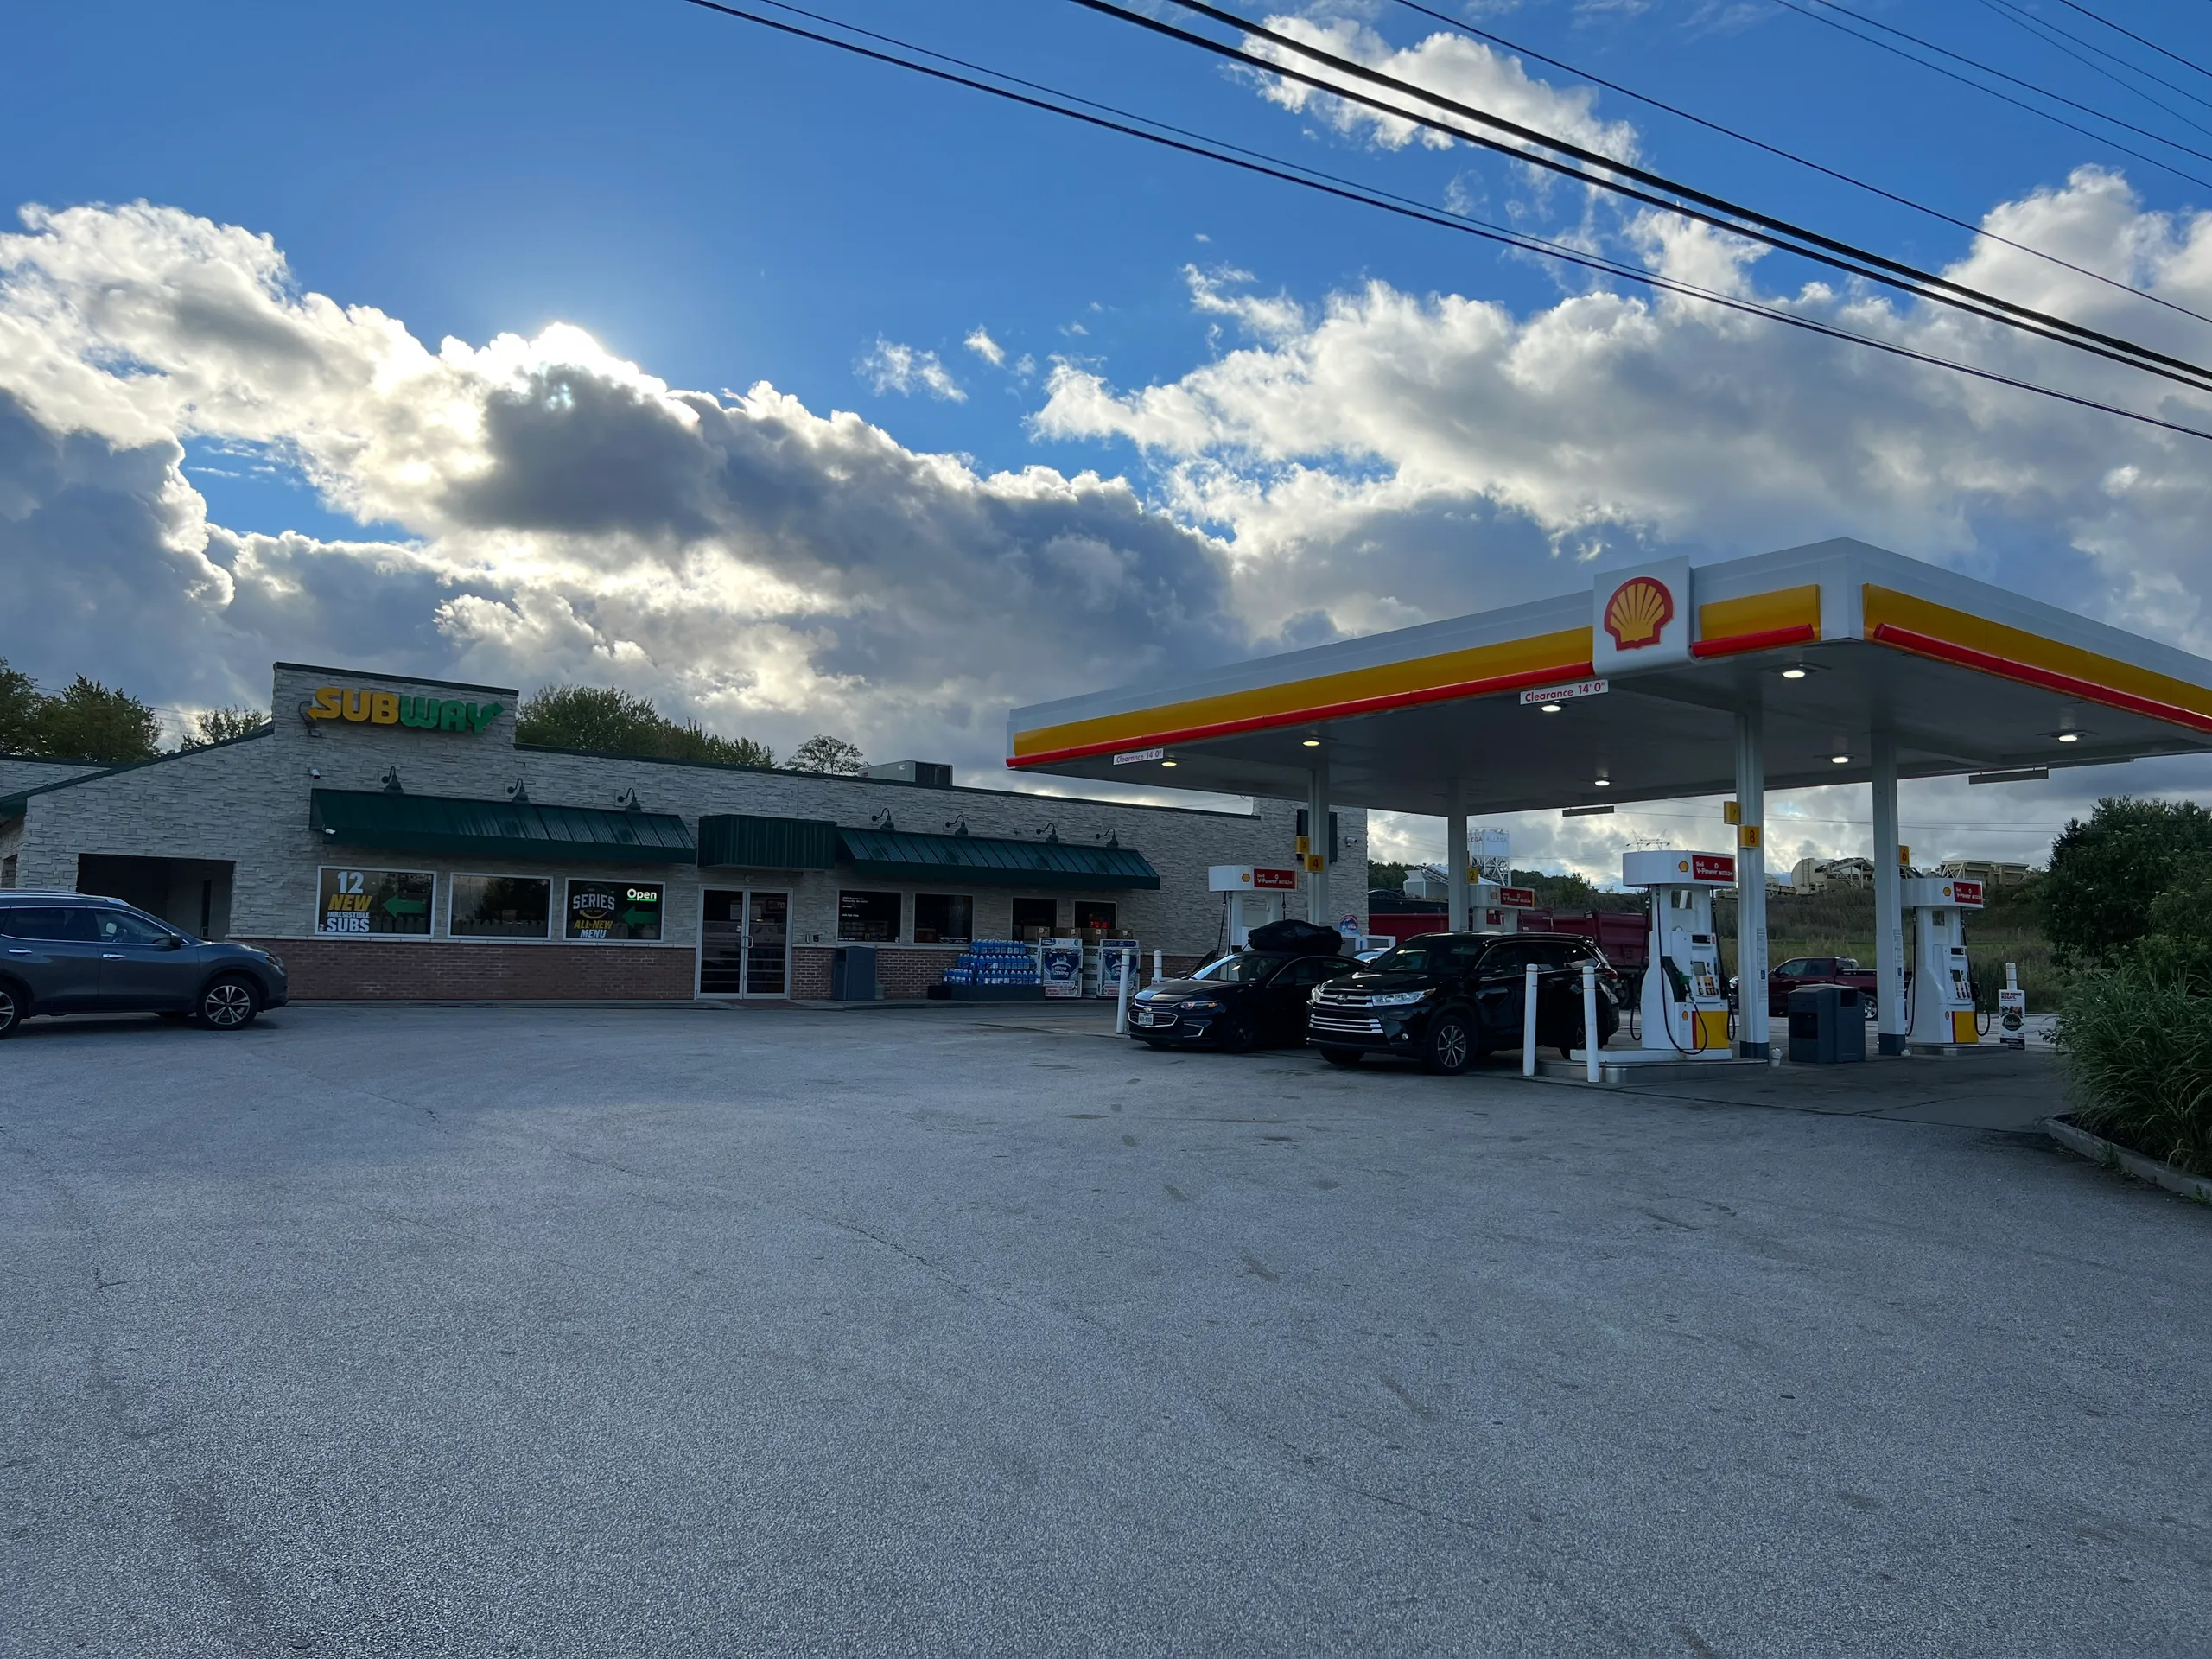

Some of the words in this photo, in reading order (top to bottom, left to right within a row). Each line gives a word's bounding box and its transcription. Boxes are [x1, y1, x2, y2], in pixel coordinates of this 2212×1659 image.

[1524, 690, 1573, 702] Clearance
[1578, 683, 1592, 694] 14'
[307, 687, 505, 734] SUBWAY
[1116, 753, 1144, 763] Clearance
[1749, 830, 1756, 844] 8
[1902, 849, 1908, 861] 6
[1313, 857, 1319, 869] 4
[1469, 870, 1476, 881] 2
[1696, 867, 1718, 875] V-Power
[337, 871, 365, 894] 12
[626, 888, 658, 901] Open
[327, 893, 373, 912] NEW
[572, 893, 615, 911] SERIES
[326, 918, 370, 933] SUBS
[573, 919, 613, 930] ALL-NEW
[580, 929, 607, 938] MENU
